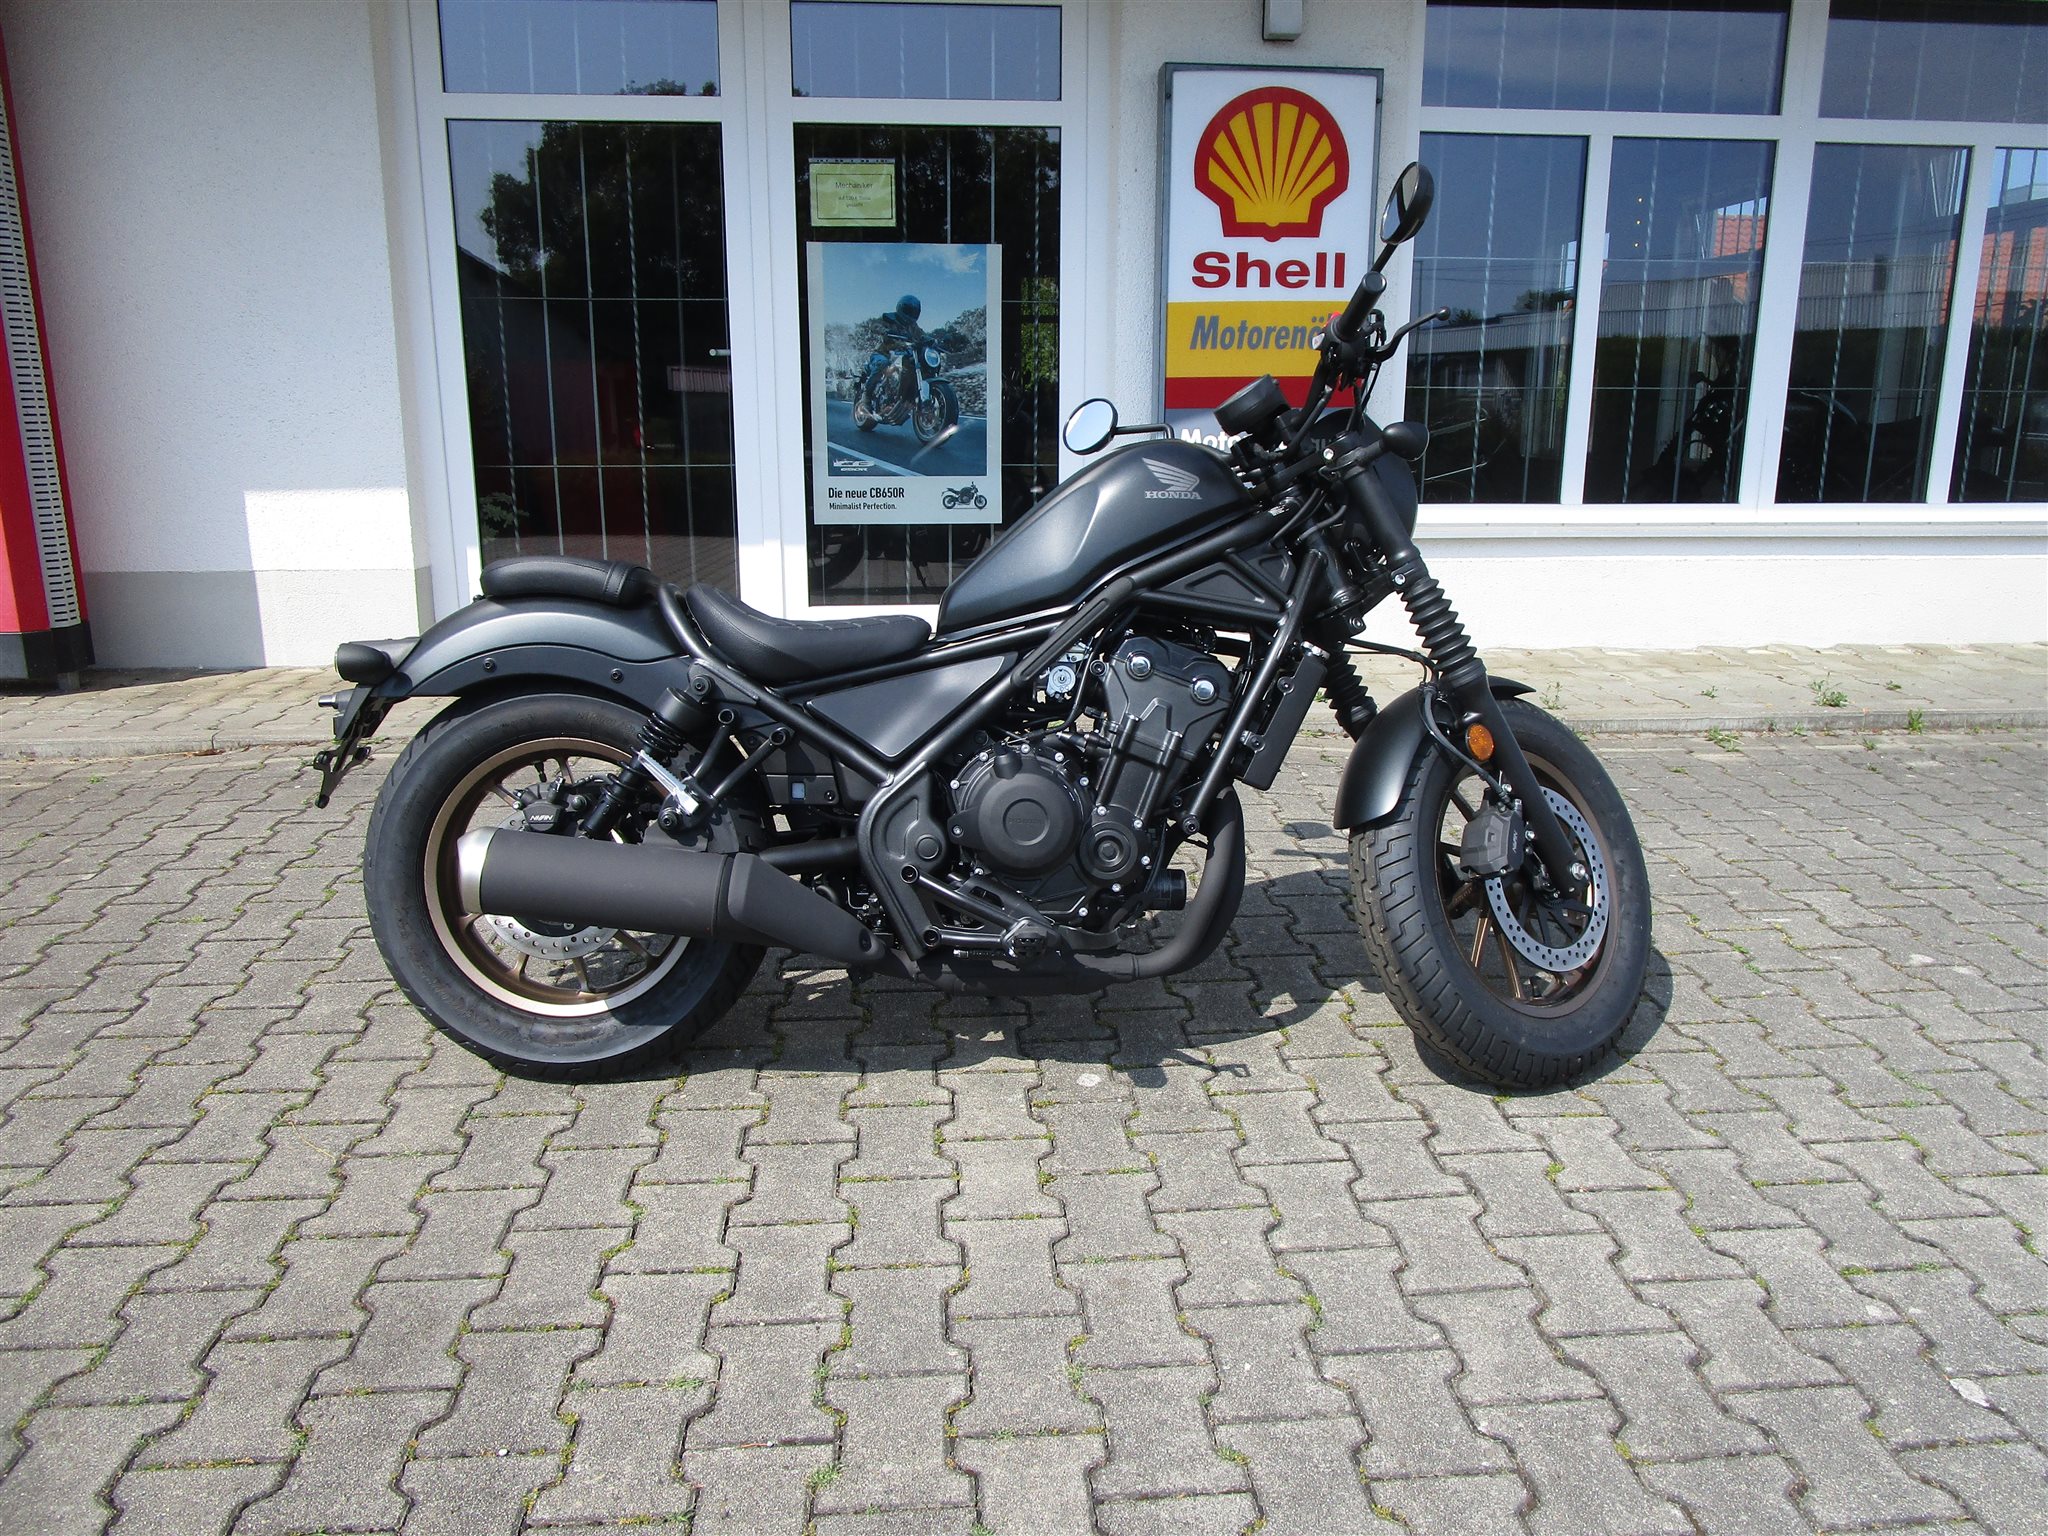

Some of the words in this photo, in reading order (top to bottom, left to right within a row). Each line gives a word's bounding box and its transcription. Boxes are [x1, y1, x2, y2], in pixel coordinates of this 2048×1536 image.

[1191, 251, 1345, 289] Shell
[1190, 313, 1332, 350] Motorenö
[828, 487, 843, 499] Die
[845, 489, 868, 499] neue
[869, 487, 905, 499] CB650R
[1145, 490, 1202, 500] HONDA
[829, 502, 862, 510] Minimalist
[863, 502, 897, 510] Perfection.
